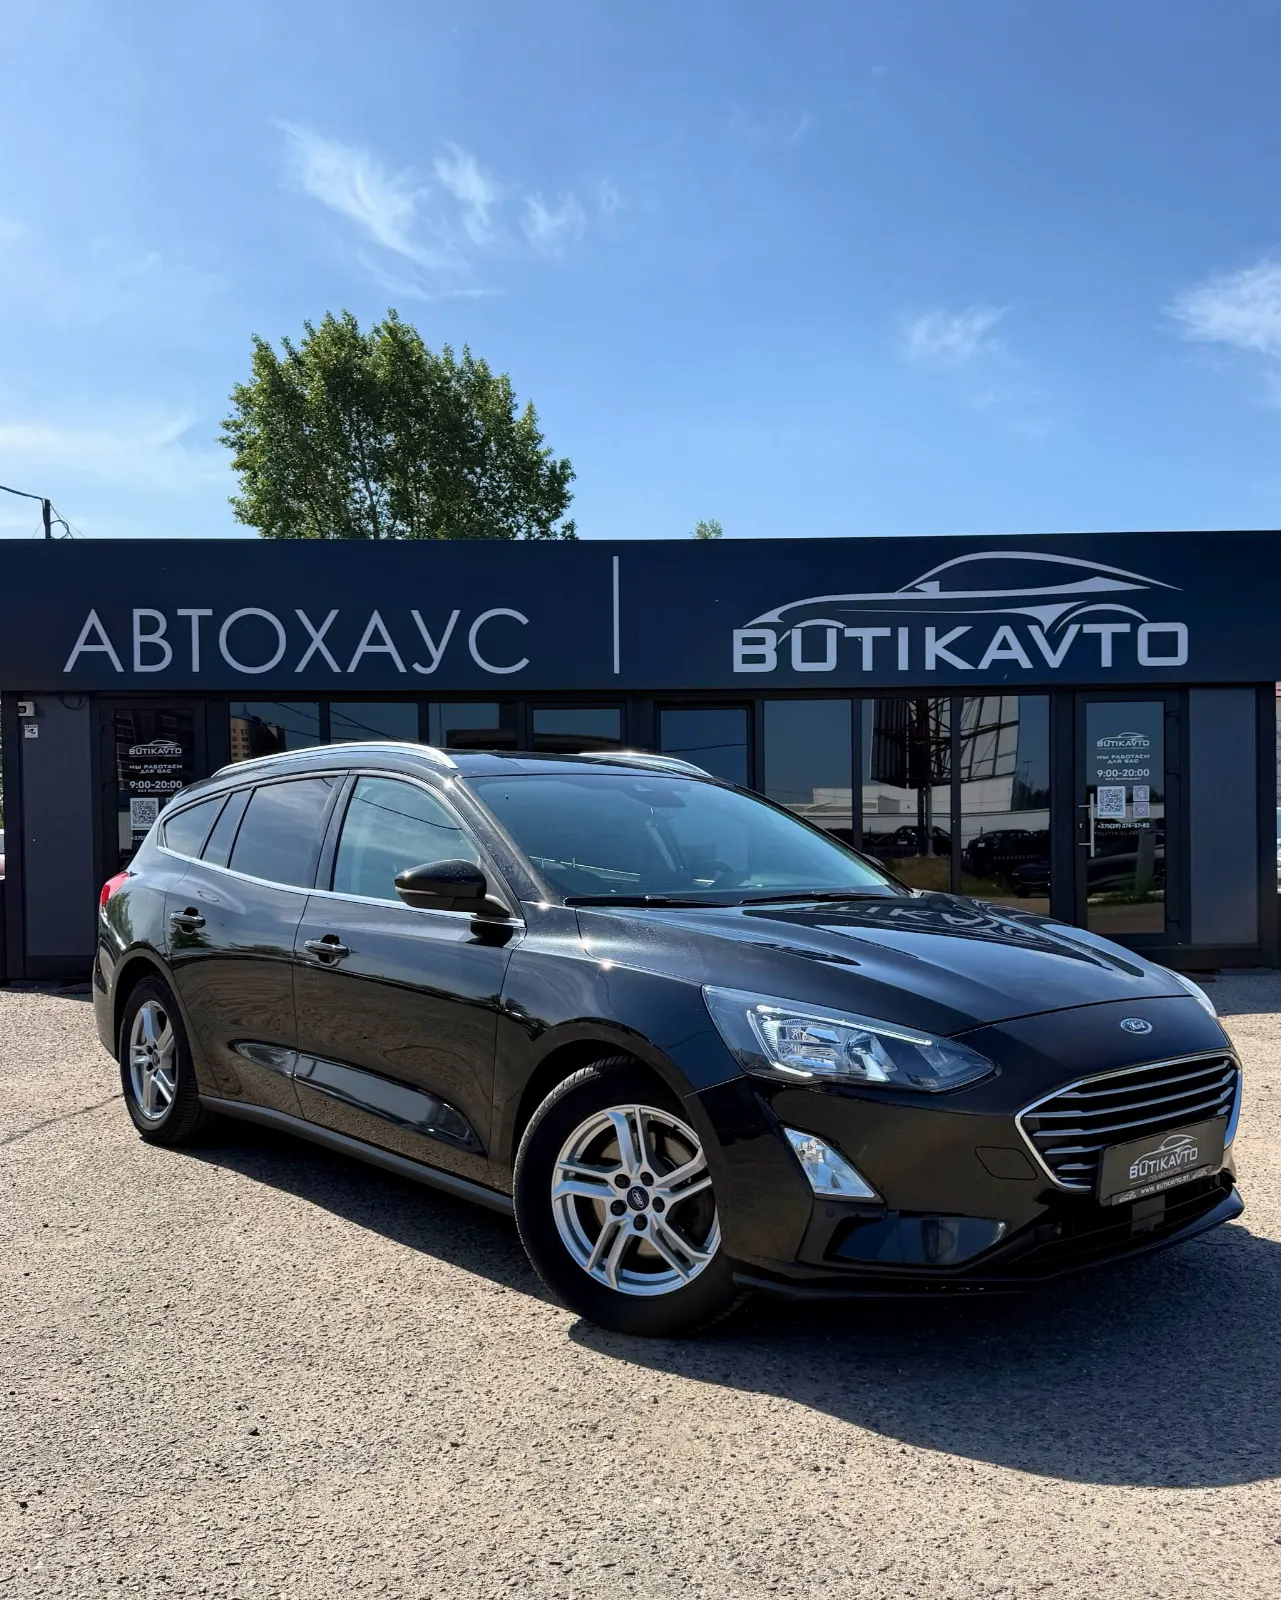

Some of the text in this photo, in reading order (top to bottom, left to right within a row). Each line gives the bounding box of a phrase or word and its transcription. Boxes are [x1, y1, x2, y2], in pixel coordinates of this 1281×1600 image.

[63, 607, 530, 674] АВТОХАУС
[732, 621, 1189, 672] BUTIKAVTO
[1097, 769, 1150, 777] 9:00-20:00
[1129, 1147, 1198, 1180] BUTIKAVTO
